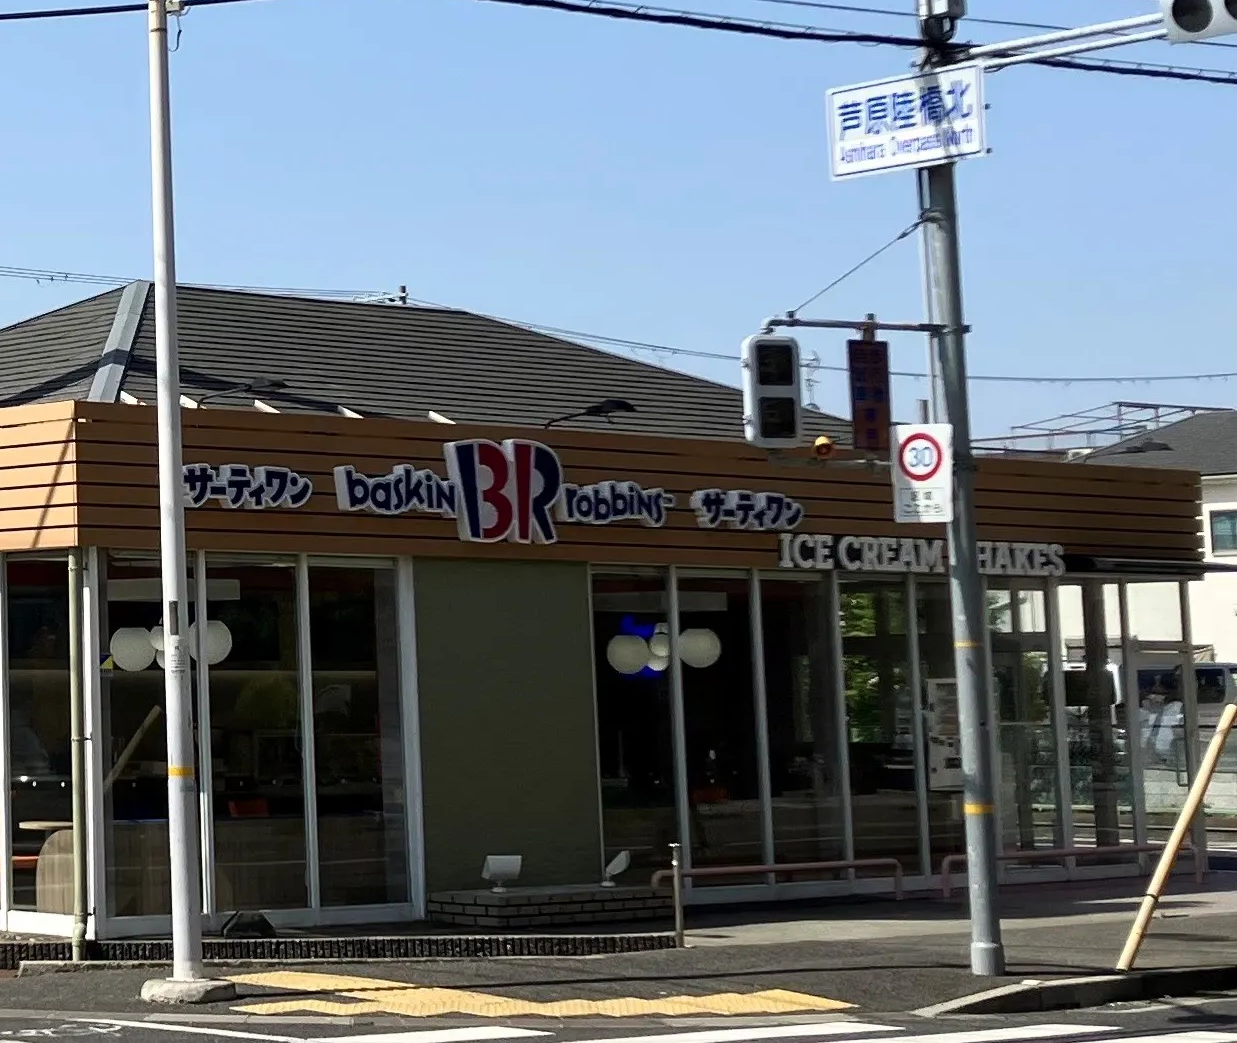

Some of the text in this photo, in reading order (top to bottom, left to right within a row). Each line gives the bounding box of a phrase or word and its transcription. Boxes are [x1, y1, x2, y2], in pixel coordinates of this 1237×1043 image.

[908, 446, 933, 468] 30
[184, 467, 310, 506] サーティワン
[702, 492, 802, 528] サーティワン
[779, 533, 1066, 577] ICE CREAM HAKES
